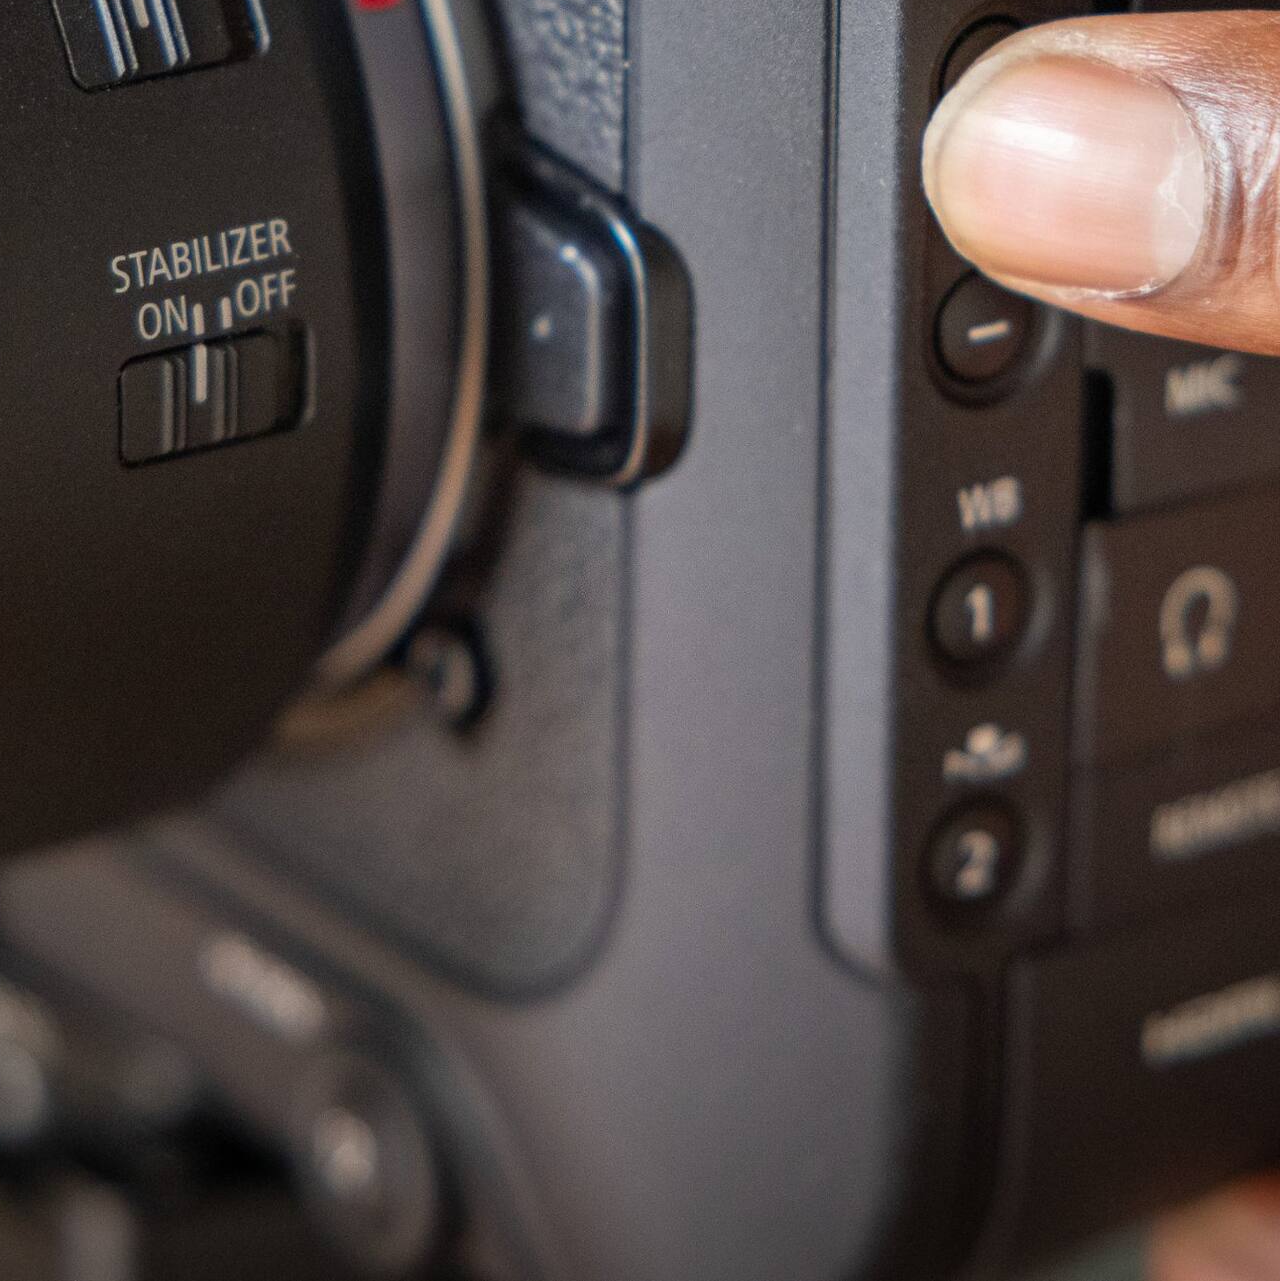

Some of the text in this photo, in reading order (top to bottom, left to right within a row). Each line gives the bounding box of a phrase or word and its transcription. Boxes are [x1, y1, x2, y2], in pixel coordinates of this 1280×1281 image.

[110, 217, 293, 294] STABILIZER
[137, 268, 297, 341] ON OFF
[965, 582, 994, 642] 1
[956, 827, 999, 900] 2
